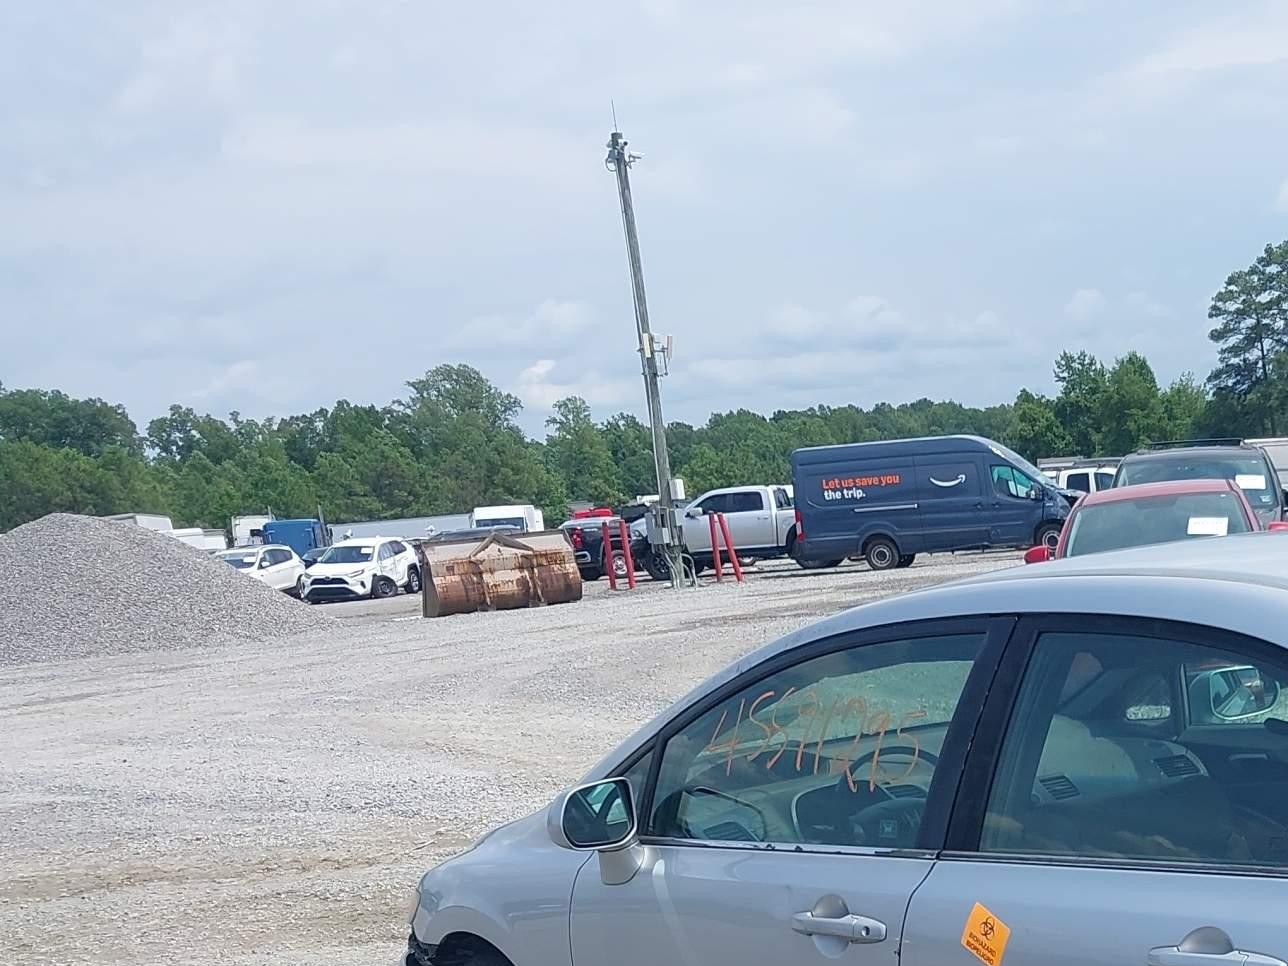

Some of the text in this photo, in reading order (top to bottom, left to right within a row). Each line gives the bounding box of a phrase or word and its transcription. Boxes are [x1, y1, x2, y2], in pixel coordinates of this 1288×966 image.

[822, 475, 900, 489] Let us save you
[823, 487, 867, 501] the trip.
[705, 686, 929, 794] 45591295
